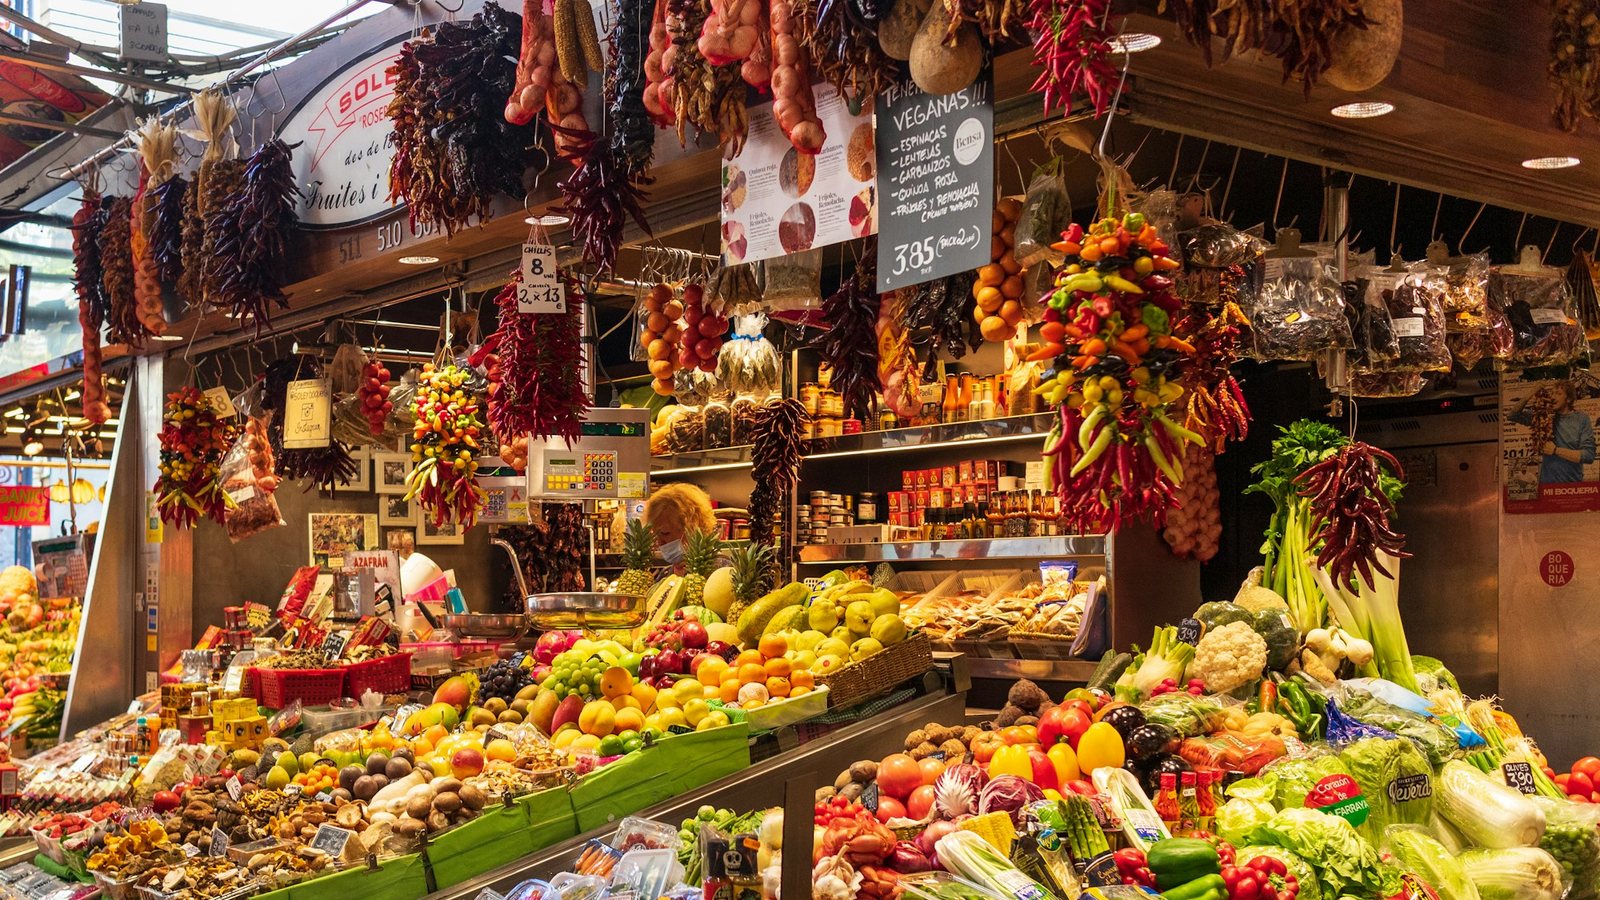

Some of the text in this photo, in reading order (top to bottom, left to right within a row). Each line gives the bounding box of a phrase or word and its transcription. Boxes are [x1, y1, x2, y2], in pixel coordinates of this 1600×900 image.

[339, 66, 398, 114] SOLE
[900, 125, 947, 152] ESPINACAS
[955, 131, 982, 150] Bensa
[366, 139, 379, 157] de
[899, 143, 942, 168] LENTEJAS
[899, 155, 951, 184] GARBANZOS
[934, 171, 958, 190] ROJA
[306, 179, 364, 211] Fruites
[378, 220, 403, 252] 510
[340, 234, 362, 264] 511
[892, 236, 934, 275] 3.85
[531, 258, 544, 275] 8
[543, 287, 560, 302] 13
[215, 395, 228, 411] 8
[1555, 486, 1599, 496] BOQUERIA
[1548, 554, 1562, 564] BO
[1548, 564, 1569, 574] QUE
[1548, 574, 1566, 584] RIA
[1316, 777, 1350, 794] Corazón
[1337, 791, 1348, 801] de
